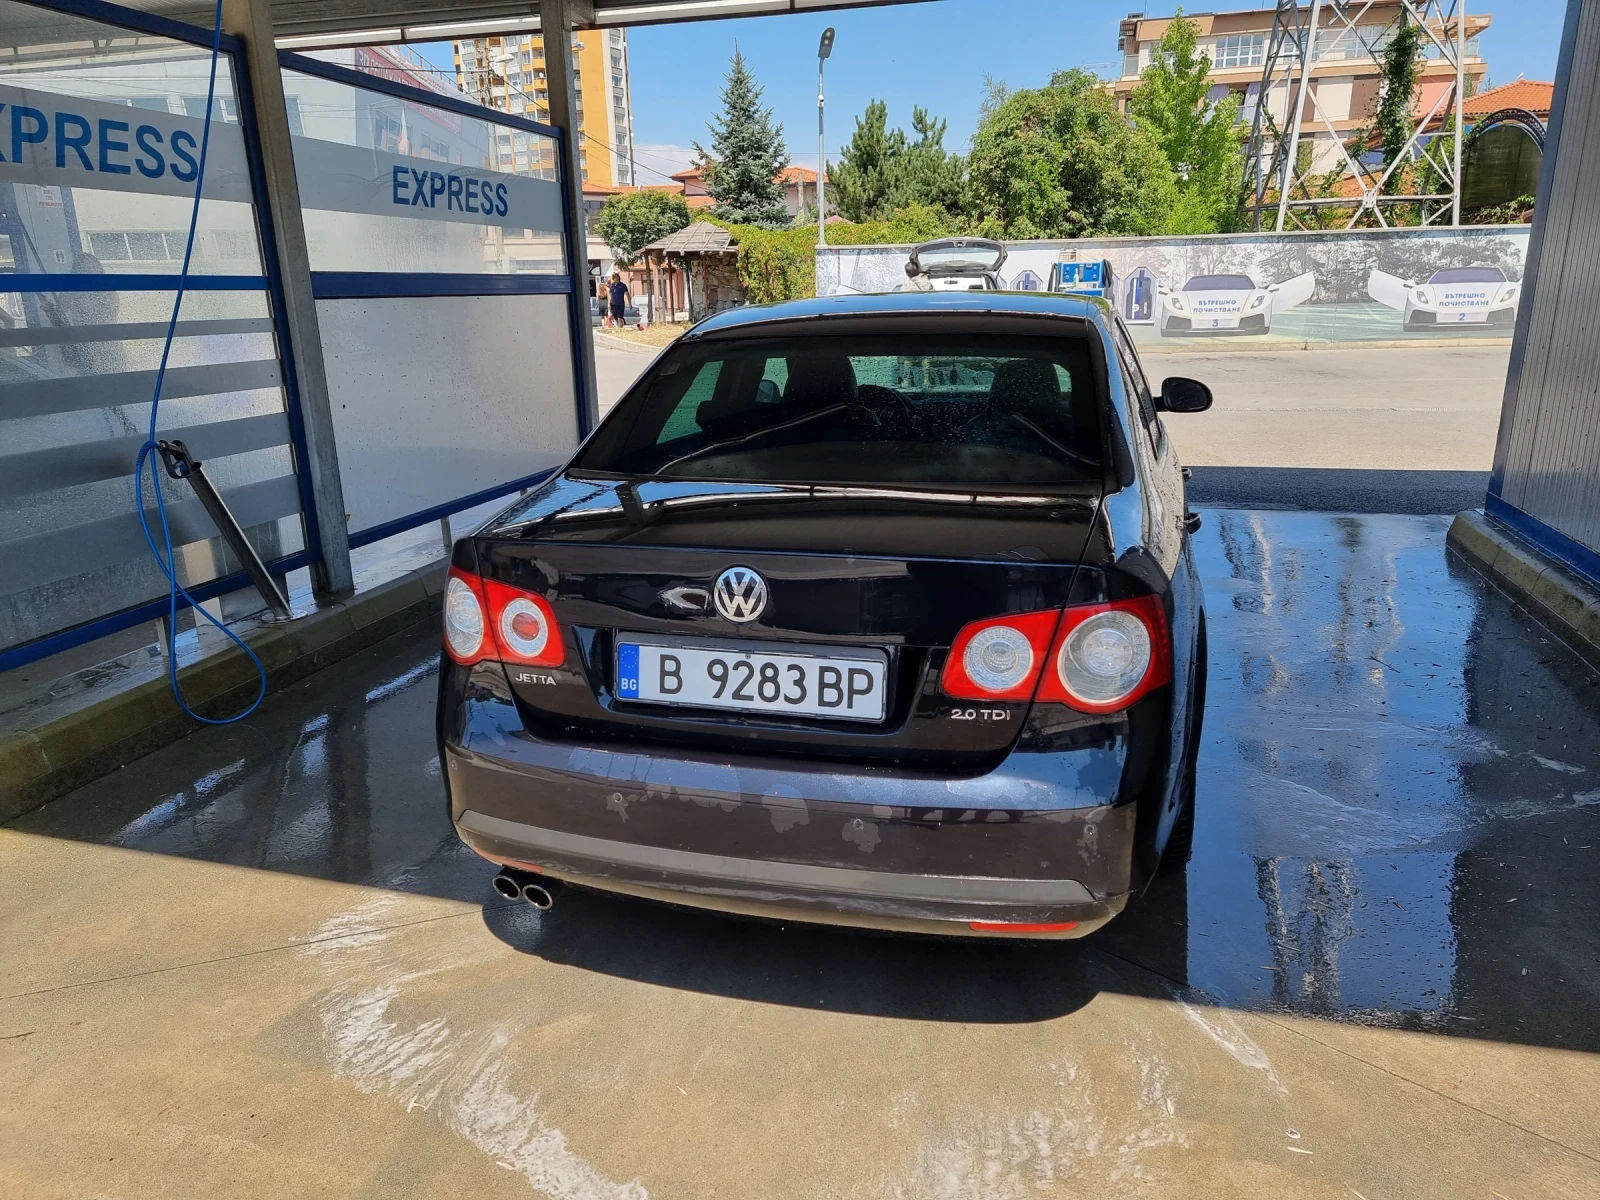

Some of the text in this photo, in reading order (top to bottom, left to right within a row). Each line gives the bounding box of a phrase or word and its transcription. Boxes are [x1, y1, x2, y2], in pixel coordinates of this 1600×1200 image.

[0, 103, 199, 182] PRESS
[393, 165, 508, 217] EXPRESS
[1212, 319, 1219, 327] 3
[1458, 312, 1466, 321] 2
[515, 672, 557, 686] JETTA
[620, 677, 637, 691] BG
[659, 653, 875, 710] B 9283 BP
[980, 709, 1011, 721] TDI
